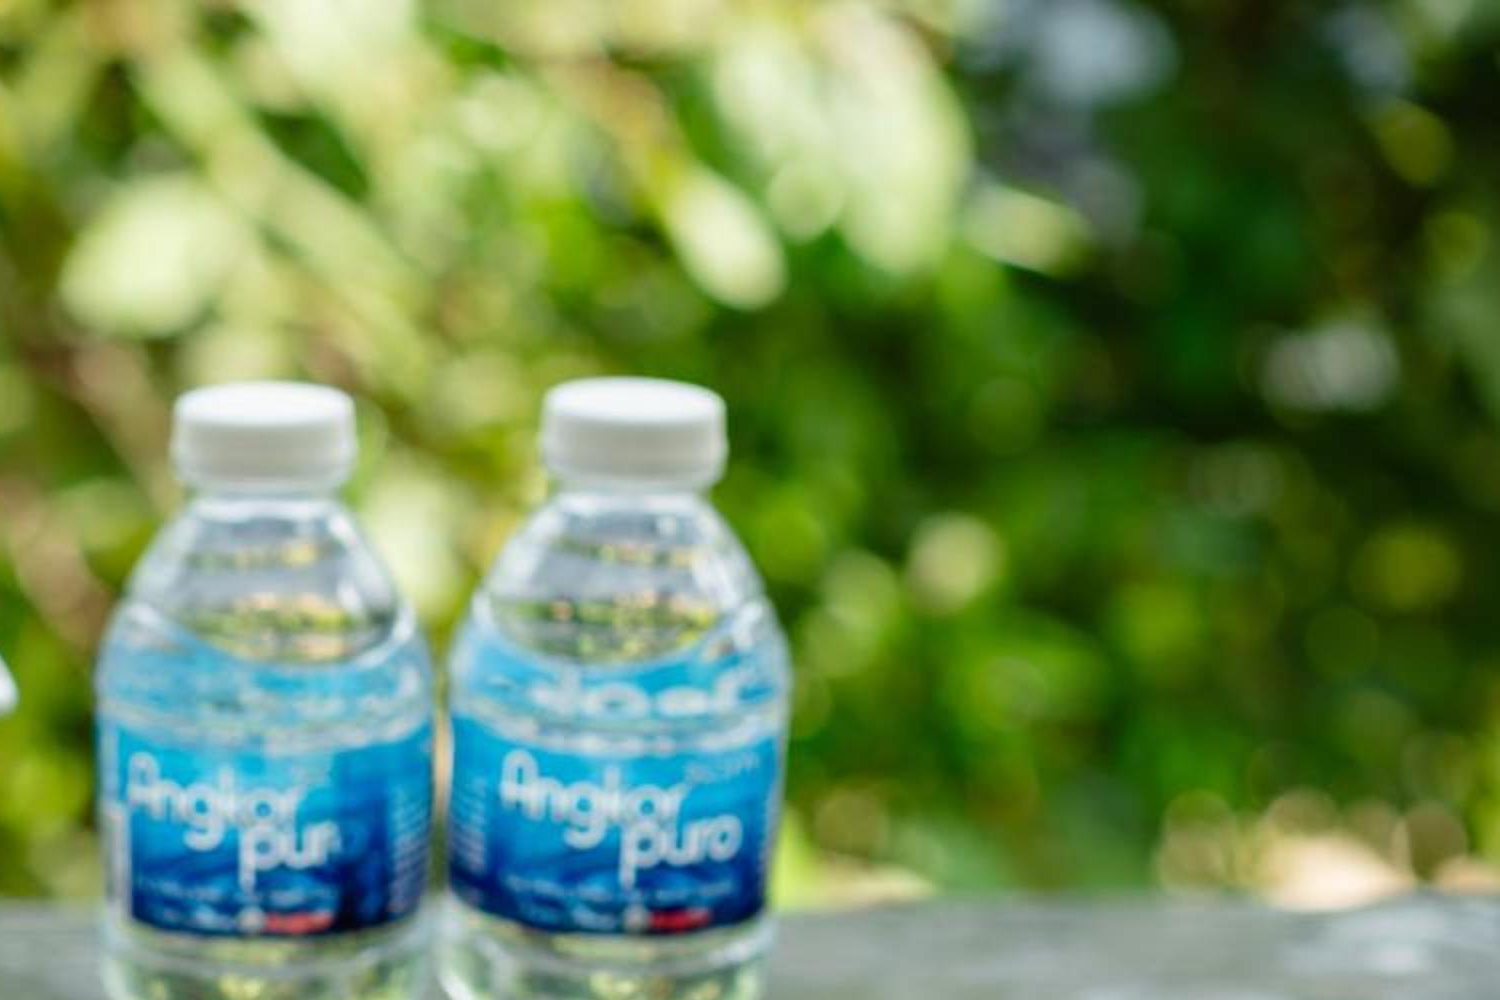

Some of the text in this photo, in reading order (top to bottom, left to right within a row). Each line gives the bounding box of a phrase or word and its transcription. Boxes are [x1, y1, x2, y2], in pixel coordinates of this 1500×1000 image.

[127, 752, 306, 851] Angkor
[501, 750, 688, 849] Angkor
[618, 815, 744, 890] puro
